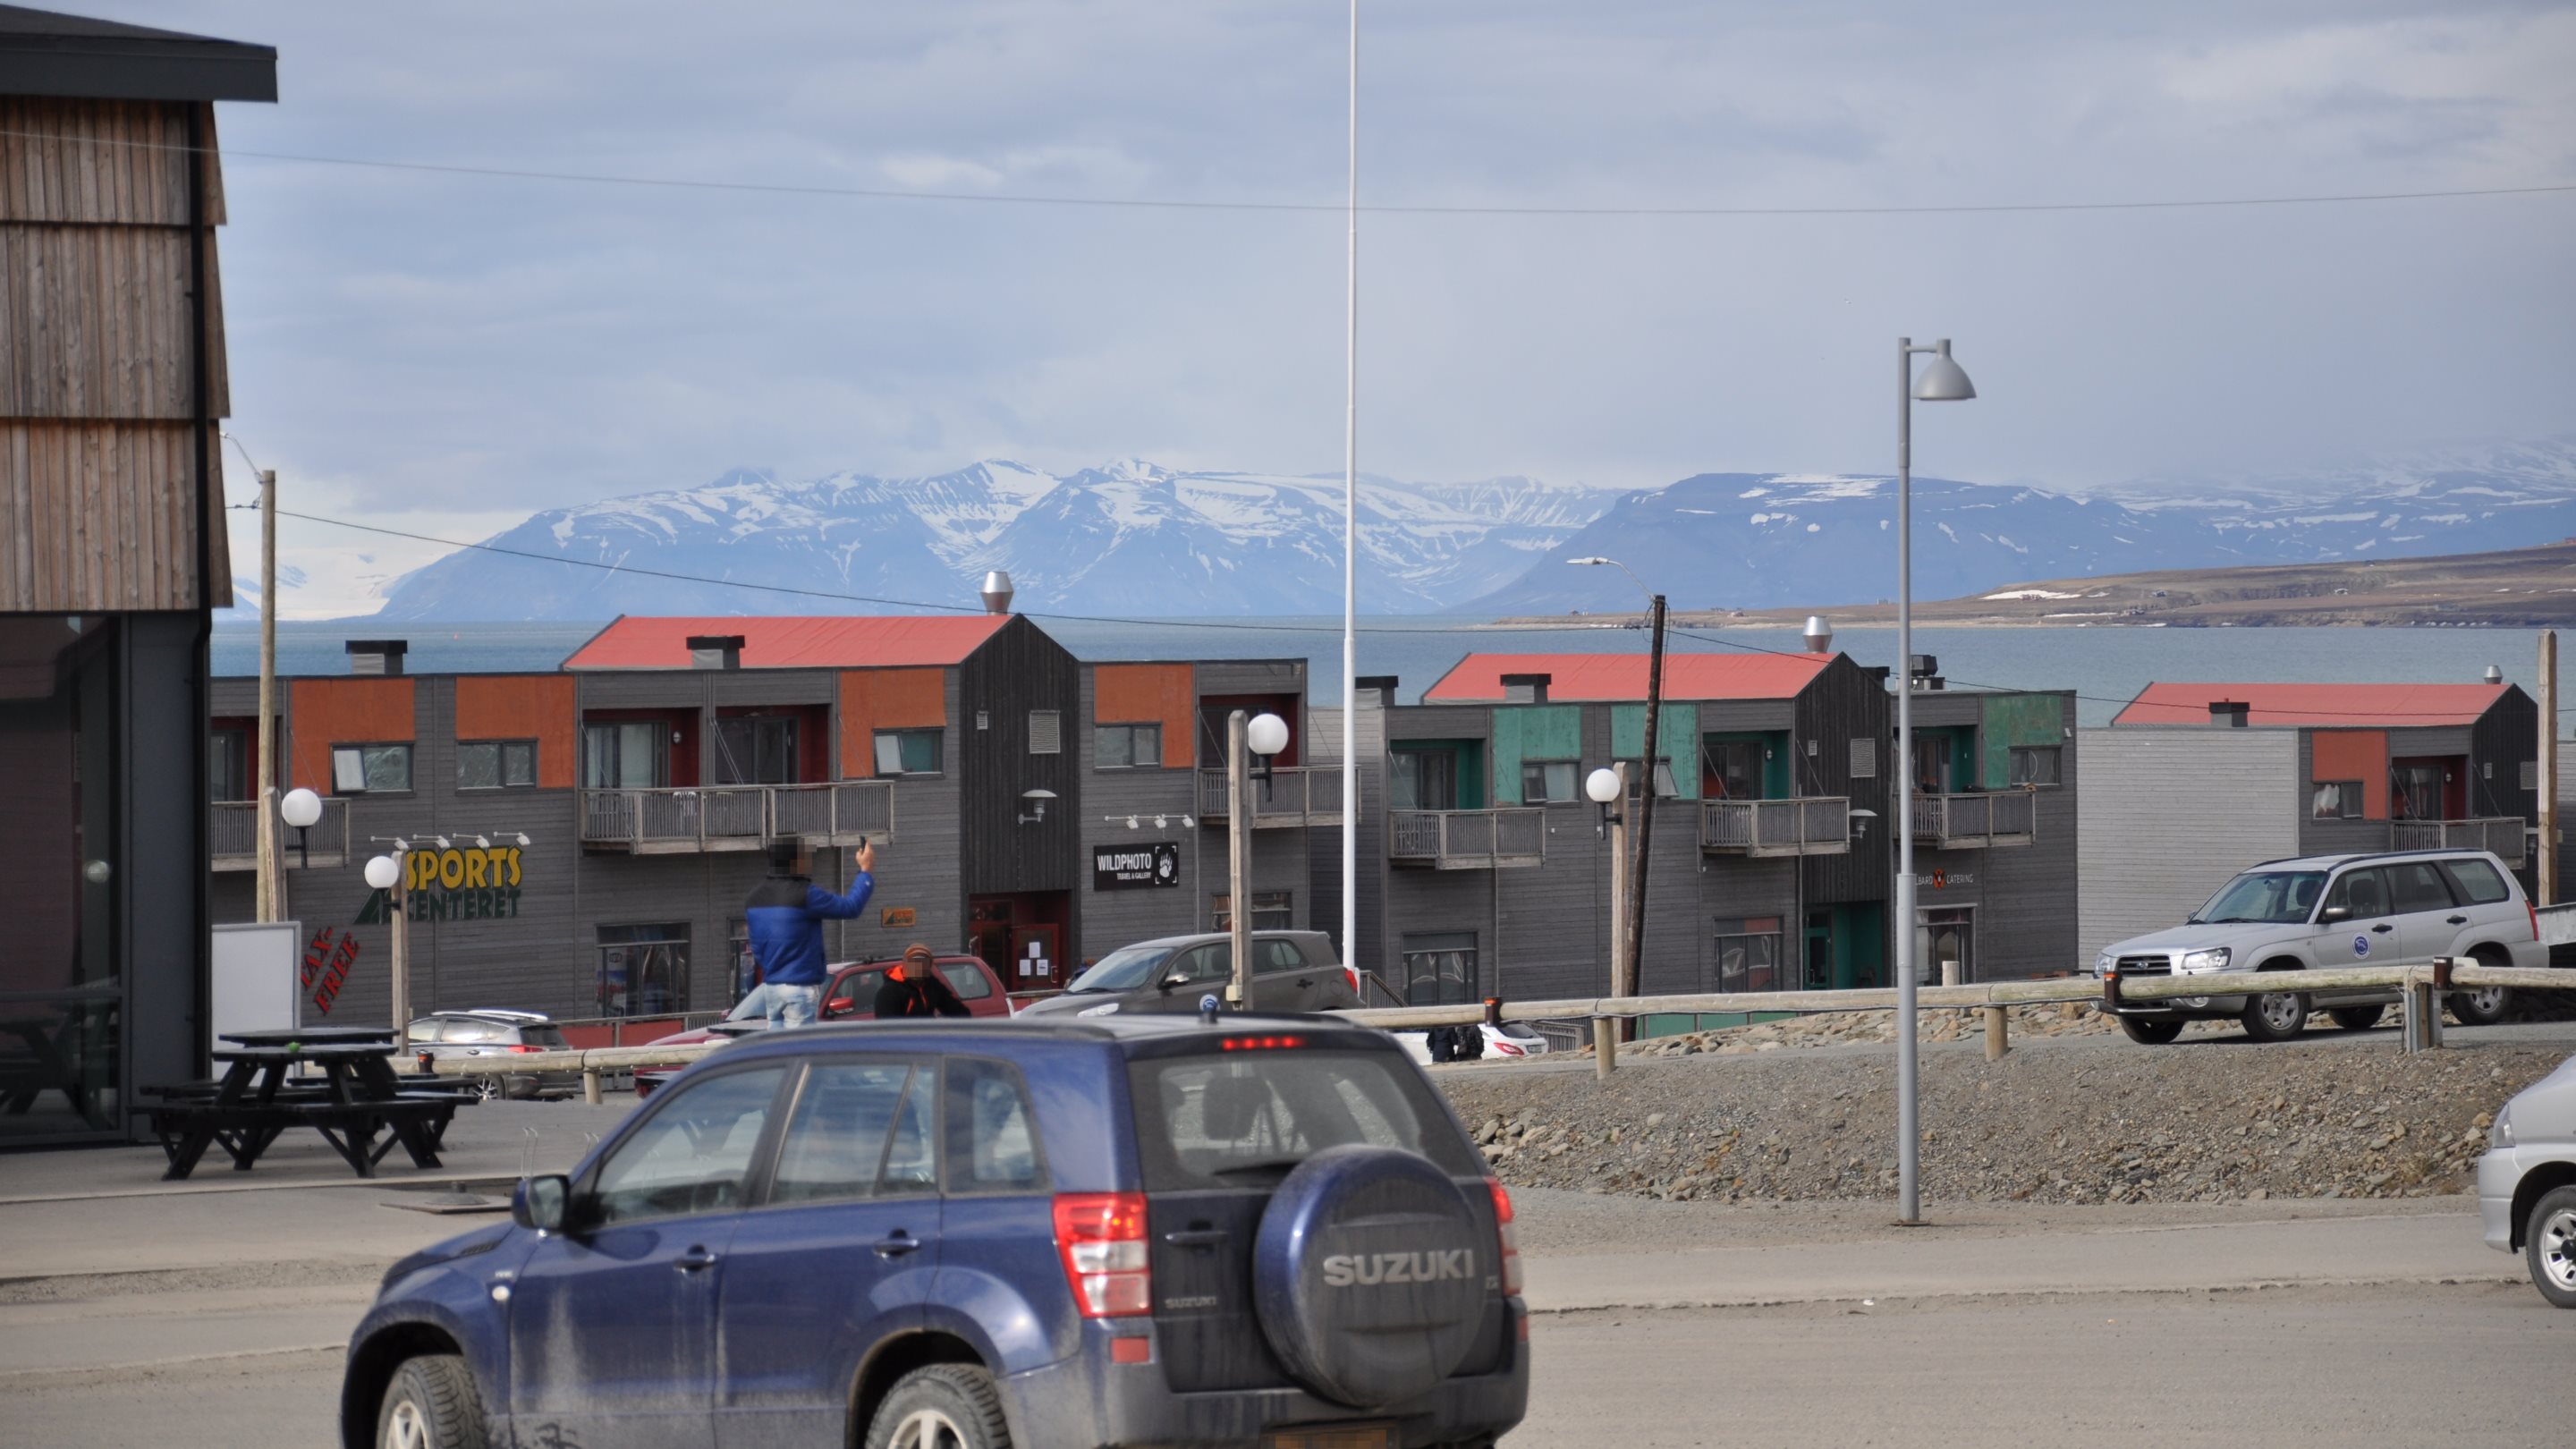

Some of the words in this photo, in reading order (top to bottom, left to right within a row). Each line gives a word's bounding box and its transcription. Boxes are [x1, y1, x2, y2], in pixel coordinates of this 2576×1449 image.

[405, 846, 522, 892] SPORTS
[1097, 853, 1152, 871] WILDPHOTO
[1915, 876, 1933, 886] BARD
[1946, 874, 1973, 884] CATERING
[313, 931, 361, 1016] FREE
[1323, 1250, 1474, 1286] SUZUKI
